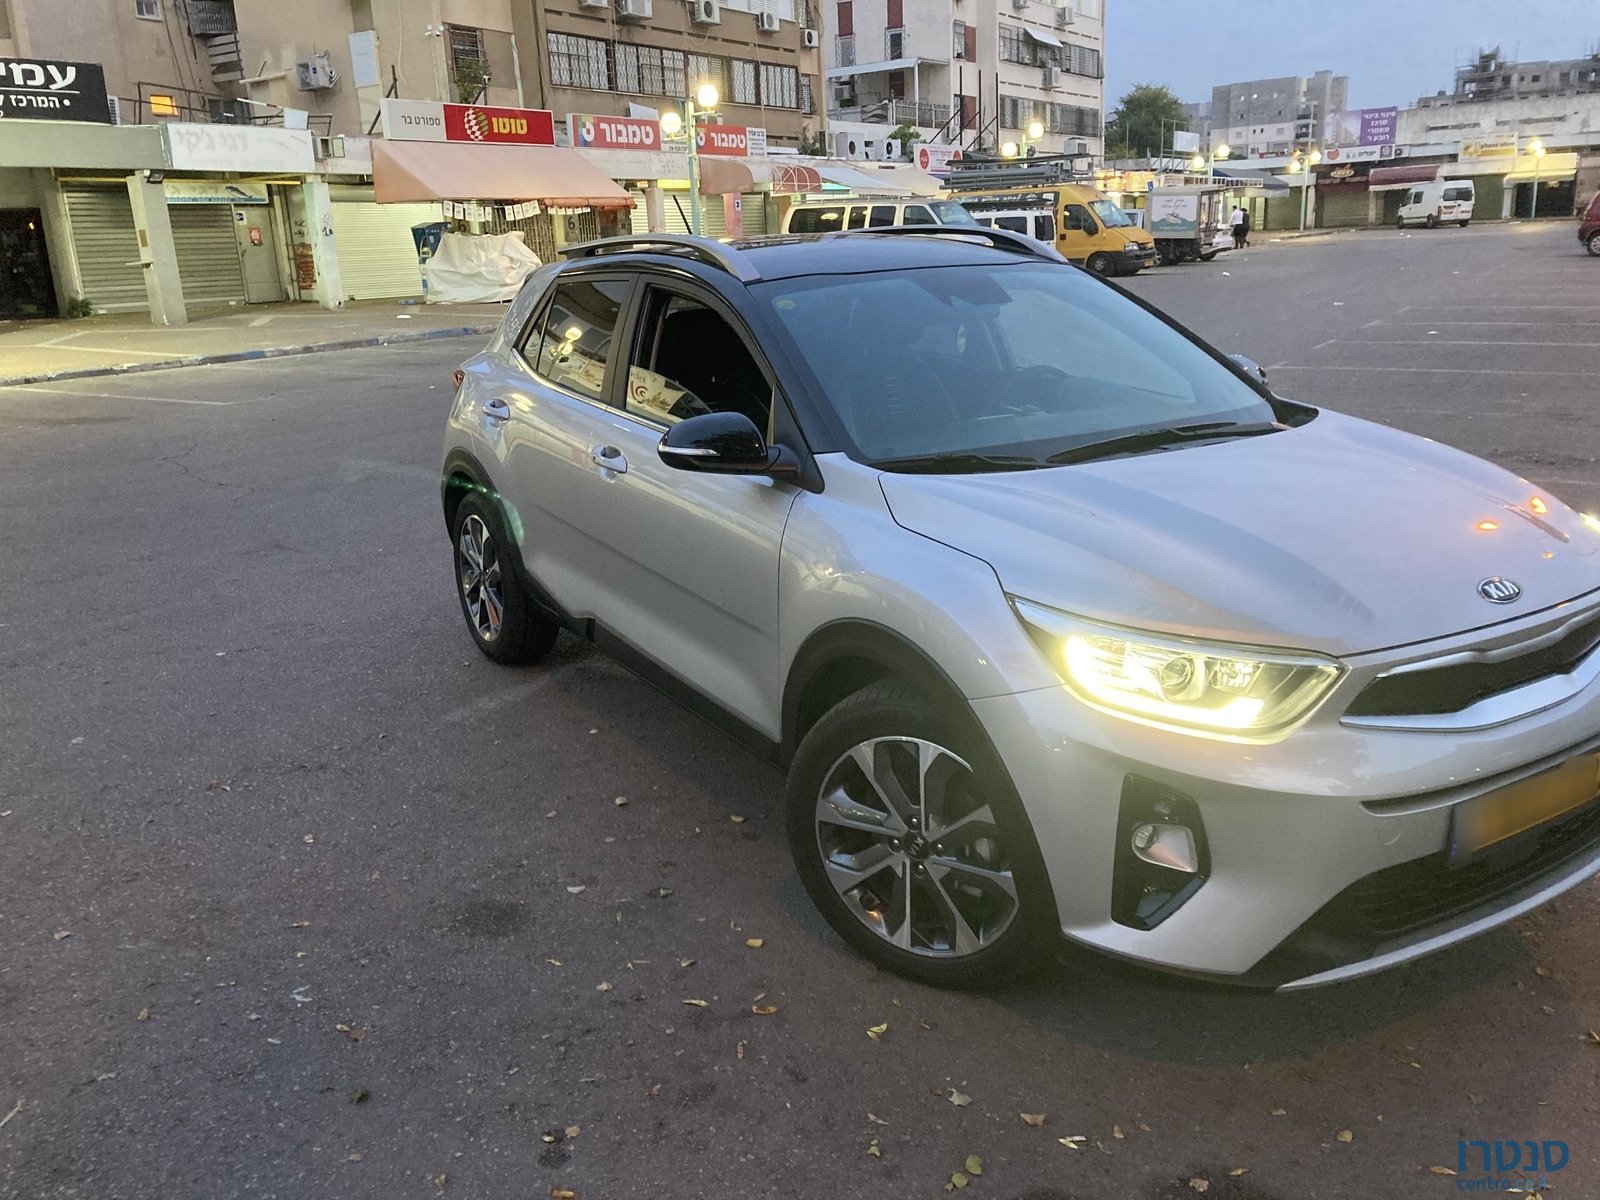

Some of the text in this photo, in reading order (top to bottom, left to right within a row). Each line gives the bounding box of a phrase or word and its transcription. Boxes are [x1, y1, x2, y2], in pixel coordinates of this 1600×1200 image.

[9, 94, 60, 109] המרכז
[401, 115, 442, 127] ספורט בר
[491, 117, 528, 135] טוטו
[600, 121, 654, 144] טמבור
[710, 131, 747, 149] טמבור
[567, 215, 576, 230] 6
[1483, 580, 1519, 599] KIA
